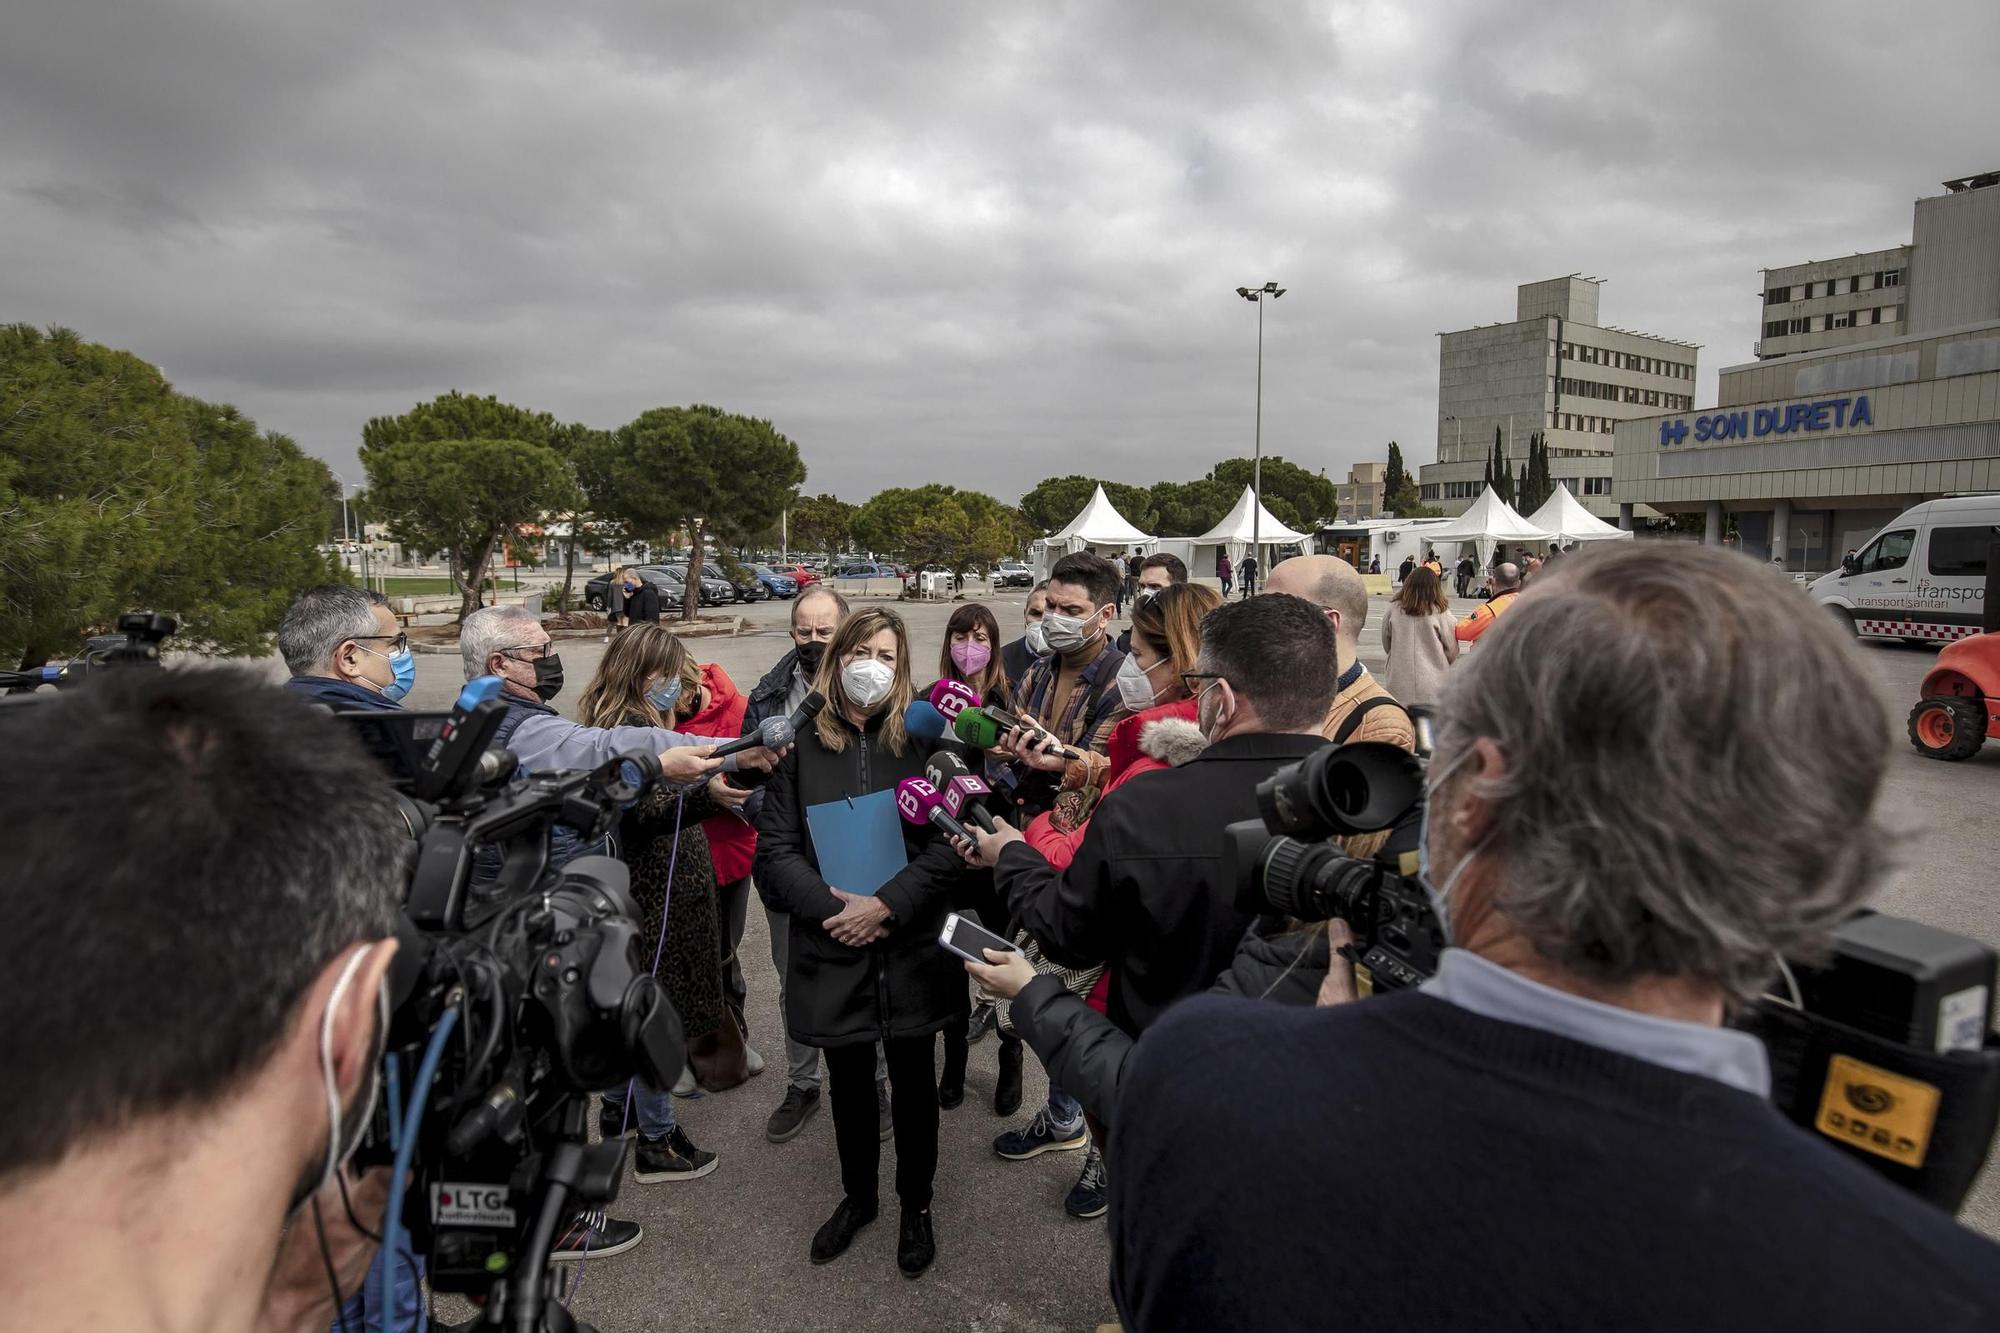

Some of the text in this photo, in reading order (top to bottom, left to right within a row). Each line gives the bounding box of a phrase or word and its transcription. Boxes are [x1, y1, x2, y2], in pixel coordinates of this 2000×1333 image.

[1694, 411, 1749, 442] SON
[1753, 395, 1873, 437] DURETA
[1857, 597, 1949, 609] transport sanitari
[455, 1188, 502, 1211] LTG
